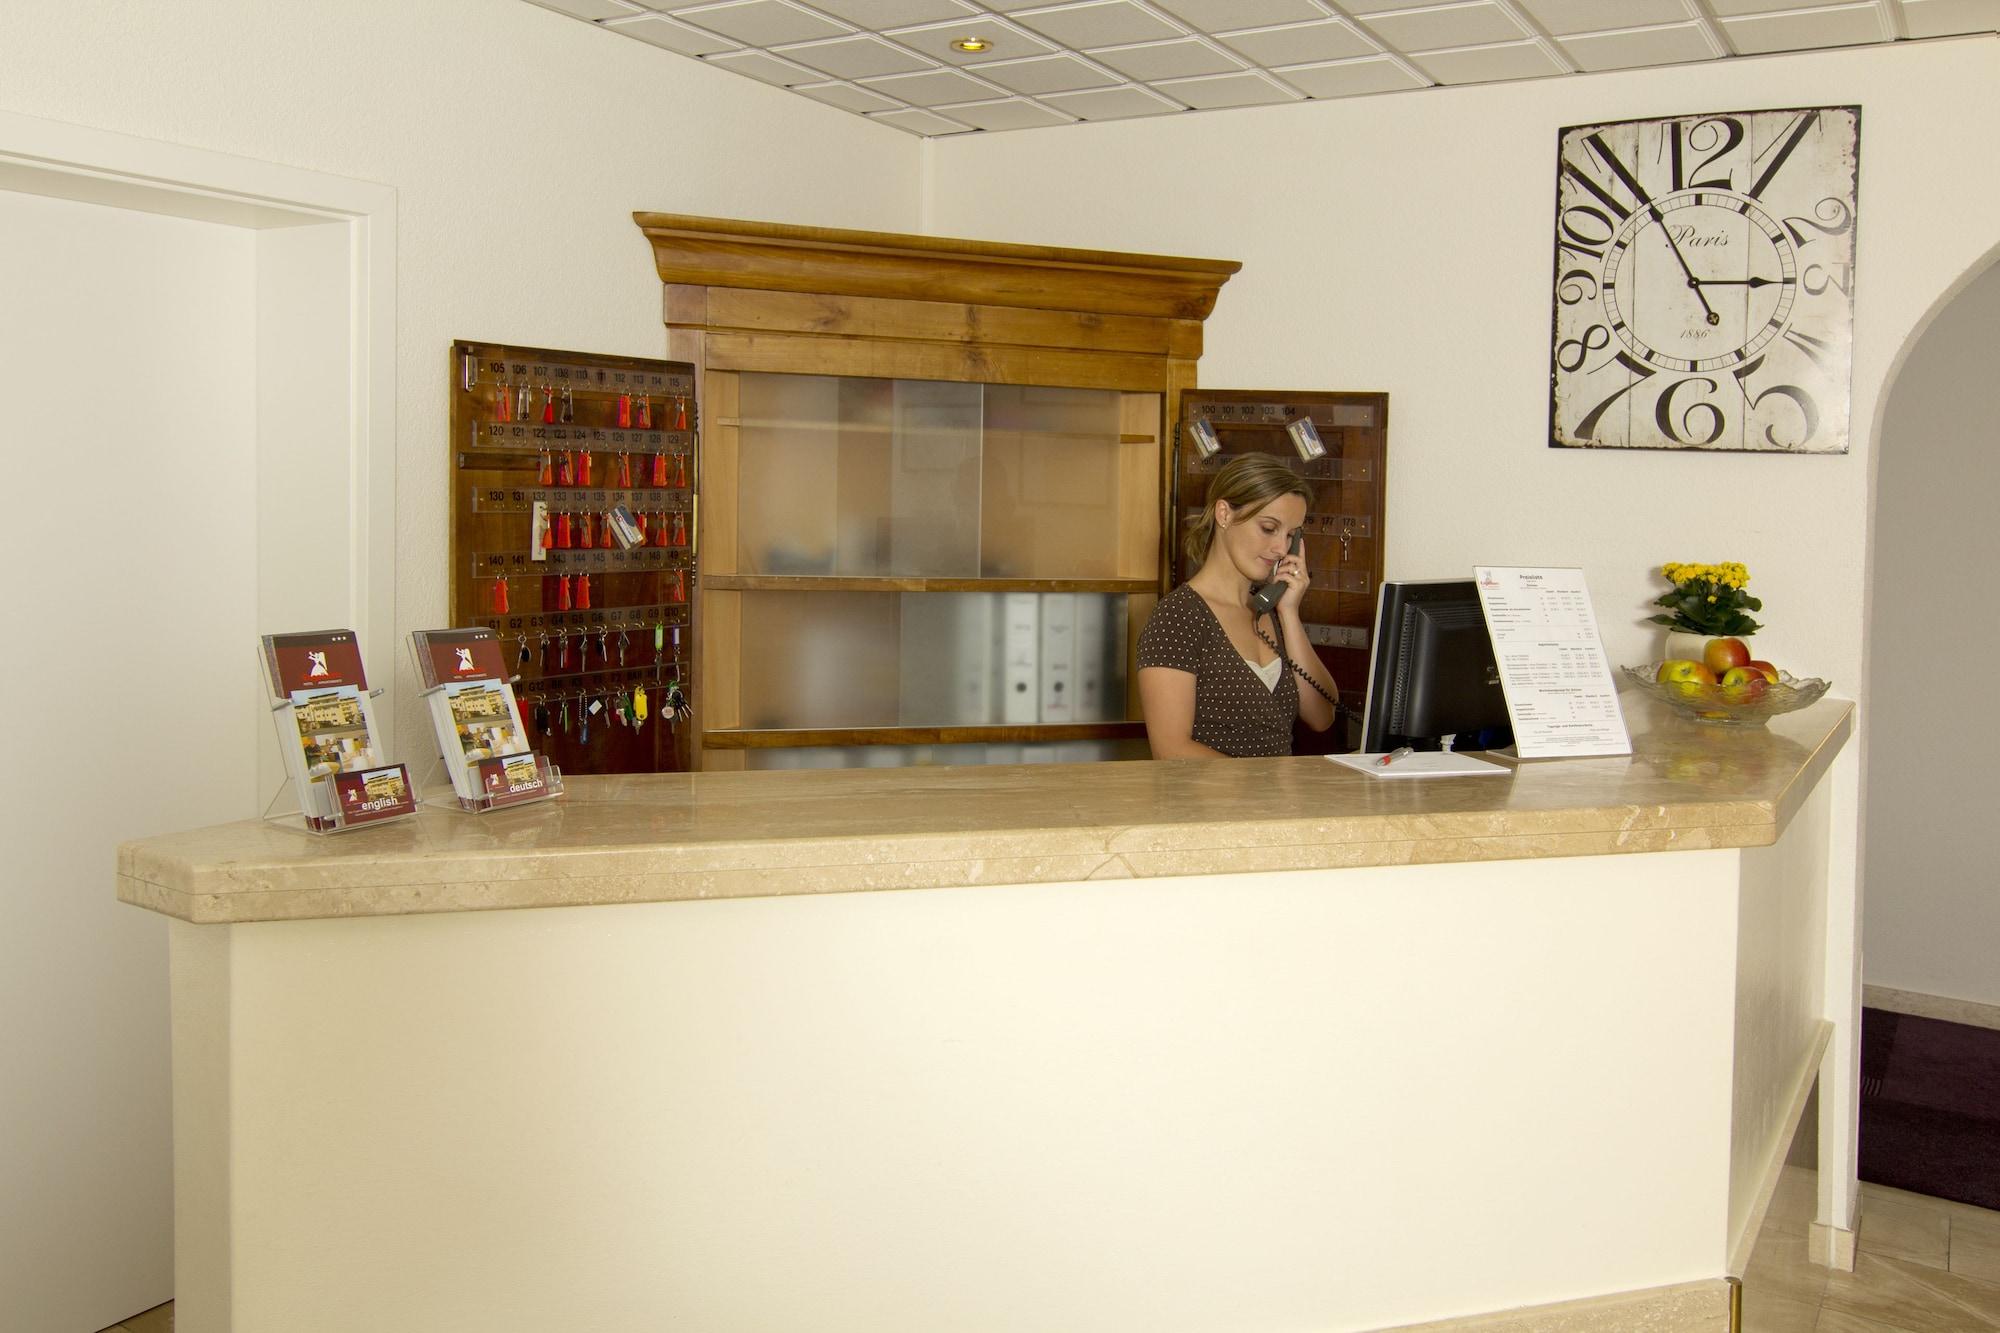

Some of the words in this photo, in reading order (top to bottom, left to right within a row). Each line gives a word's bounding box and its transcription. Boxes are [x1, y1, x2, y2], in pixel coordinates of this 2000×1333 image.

[1657, 116, 1744, 194] 12
[1740, 111, 1823, 204] 1
[1559, 205, 1614, 264] 10
[1665, 224, 1730, 249] Paris
[1782, 197, 1852, 249] 2
[1558, 269, 1598, 306] 9
[1802, 261, 1851, 297] 3
[1557, 323, 1610, 373] 8
[489, 362, 505, 374] 105
[512, 364, 527, 375] 106
[533, 366, 547, 376] 107
[1201, 405, 1216, 415] 100
[1222, 406, 1235, 415] 101
[1241, 406, 1255, 415] 102
[1261, 406, 1276, 415] 103
[1281, 406, 1296, 416] 104
[1573, 349, 1657, 441] 7
[1654, 376, 1726, 446] 6
[1732, 353, 1820, 449] 5
[489, 426, 504, 436] 120
[512, 427, 525, 437] 121
[533, 428, 546, 438] 122
[553, 429, 567, 439] 123
[489, 491, 504, 501] 130
[512, 491, 525, 501] 131
[1321, 516, 1335, 526] 177
[1343, 517, 1356, 527] 178
[489, 555, 504, 566] 140
[512, 554, 525, 565] 141
[361, 795, 399, 811] english
[509, 778, 543, 793] deutsch
